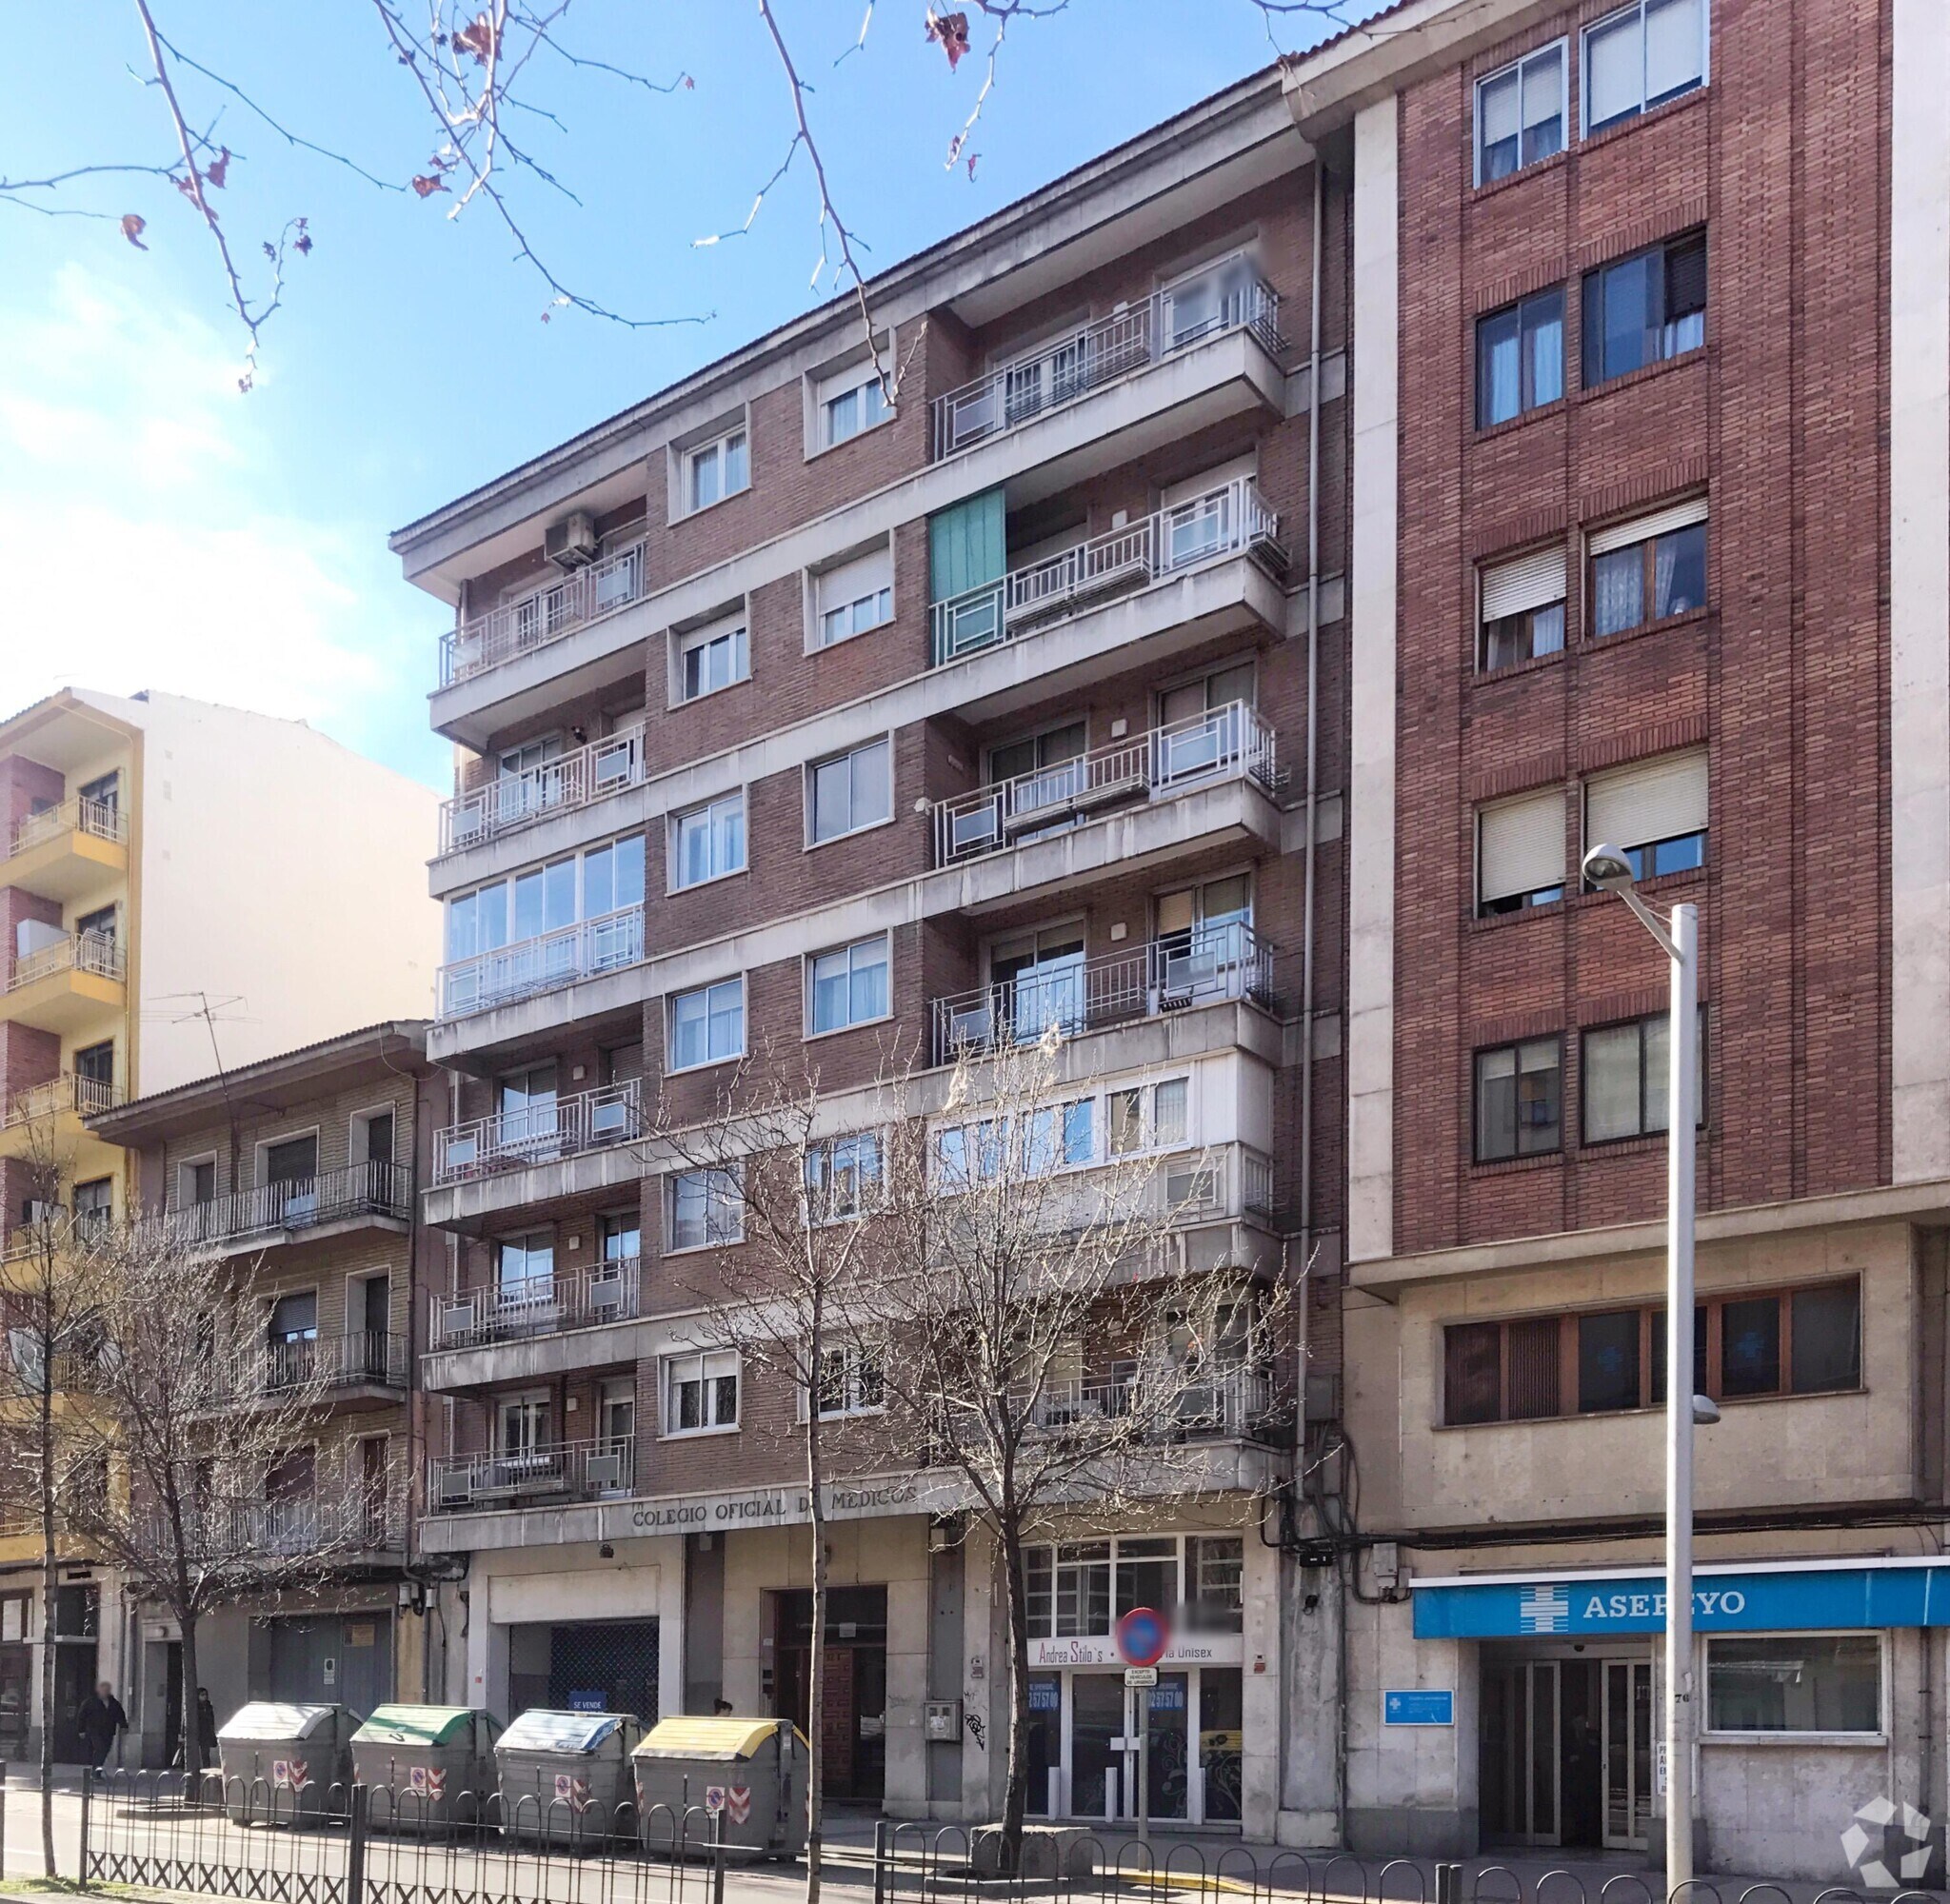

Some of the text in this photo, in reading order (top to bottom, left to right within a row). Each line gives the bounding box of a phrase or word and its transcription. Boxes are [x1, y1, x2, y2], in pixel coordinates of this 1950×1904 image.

[633, 1506, 707, 1527] COLEGIO
[716, 1499, 786, 1519] OFICIAL
[831, 1486, 918, 1510] MEDICOS
[1582, 1591, 1745, 1618] ASEPYO
[1039, 1641, 1068, 1664] Andrea
[1178, 1647, 1213, 1658] Unisex
[573, 1701, 602, 1710] SE VENDE
